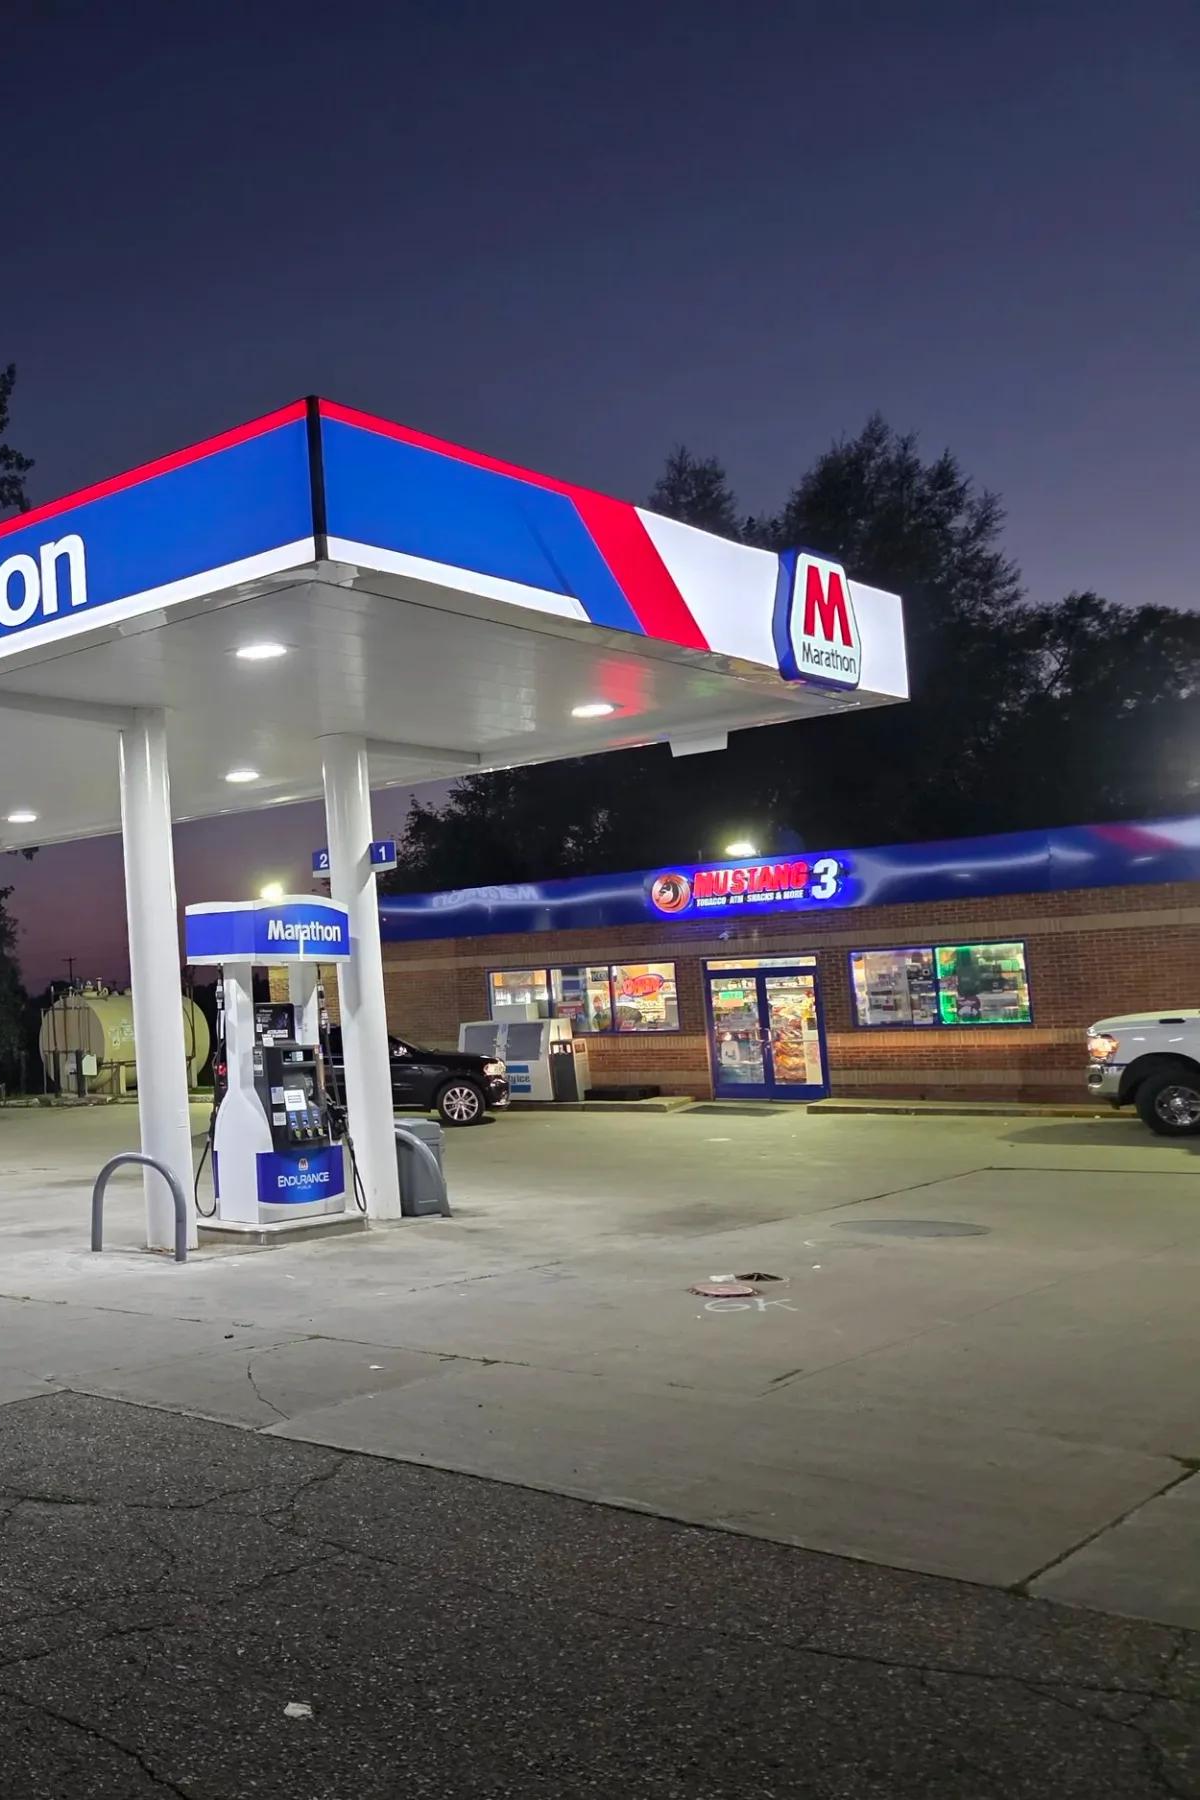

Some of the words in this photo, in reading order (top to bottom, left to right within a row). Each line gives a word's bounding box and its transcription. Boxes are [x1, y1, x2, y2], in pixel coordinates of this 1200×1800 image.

[803, 564, 853, 648] M
[802, 641, 857, 674] Marathon
[320, 853, 329, 868] 2
[379, 846, 386, 860] 1
[694, 861, 809, 899] MUSTANG
[811, 858, 839, 899] 3
[696, 896, 727, 907] TOBACCO
[729, 895, 743, 904] ATM
[747, 892, 775, 903] SNACKS
[775, 891, 782, 900] &
[783, 889, 804, 899] MORE
[267, 919, 342, 942] Marathon
[277, 1171, 330, 1188] ENDURANCE
